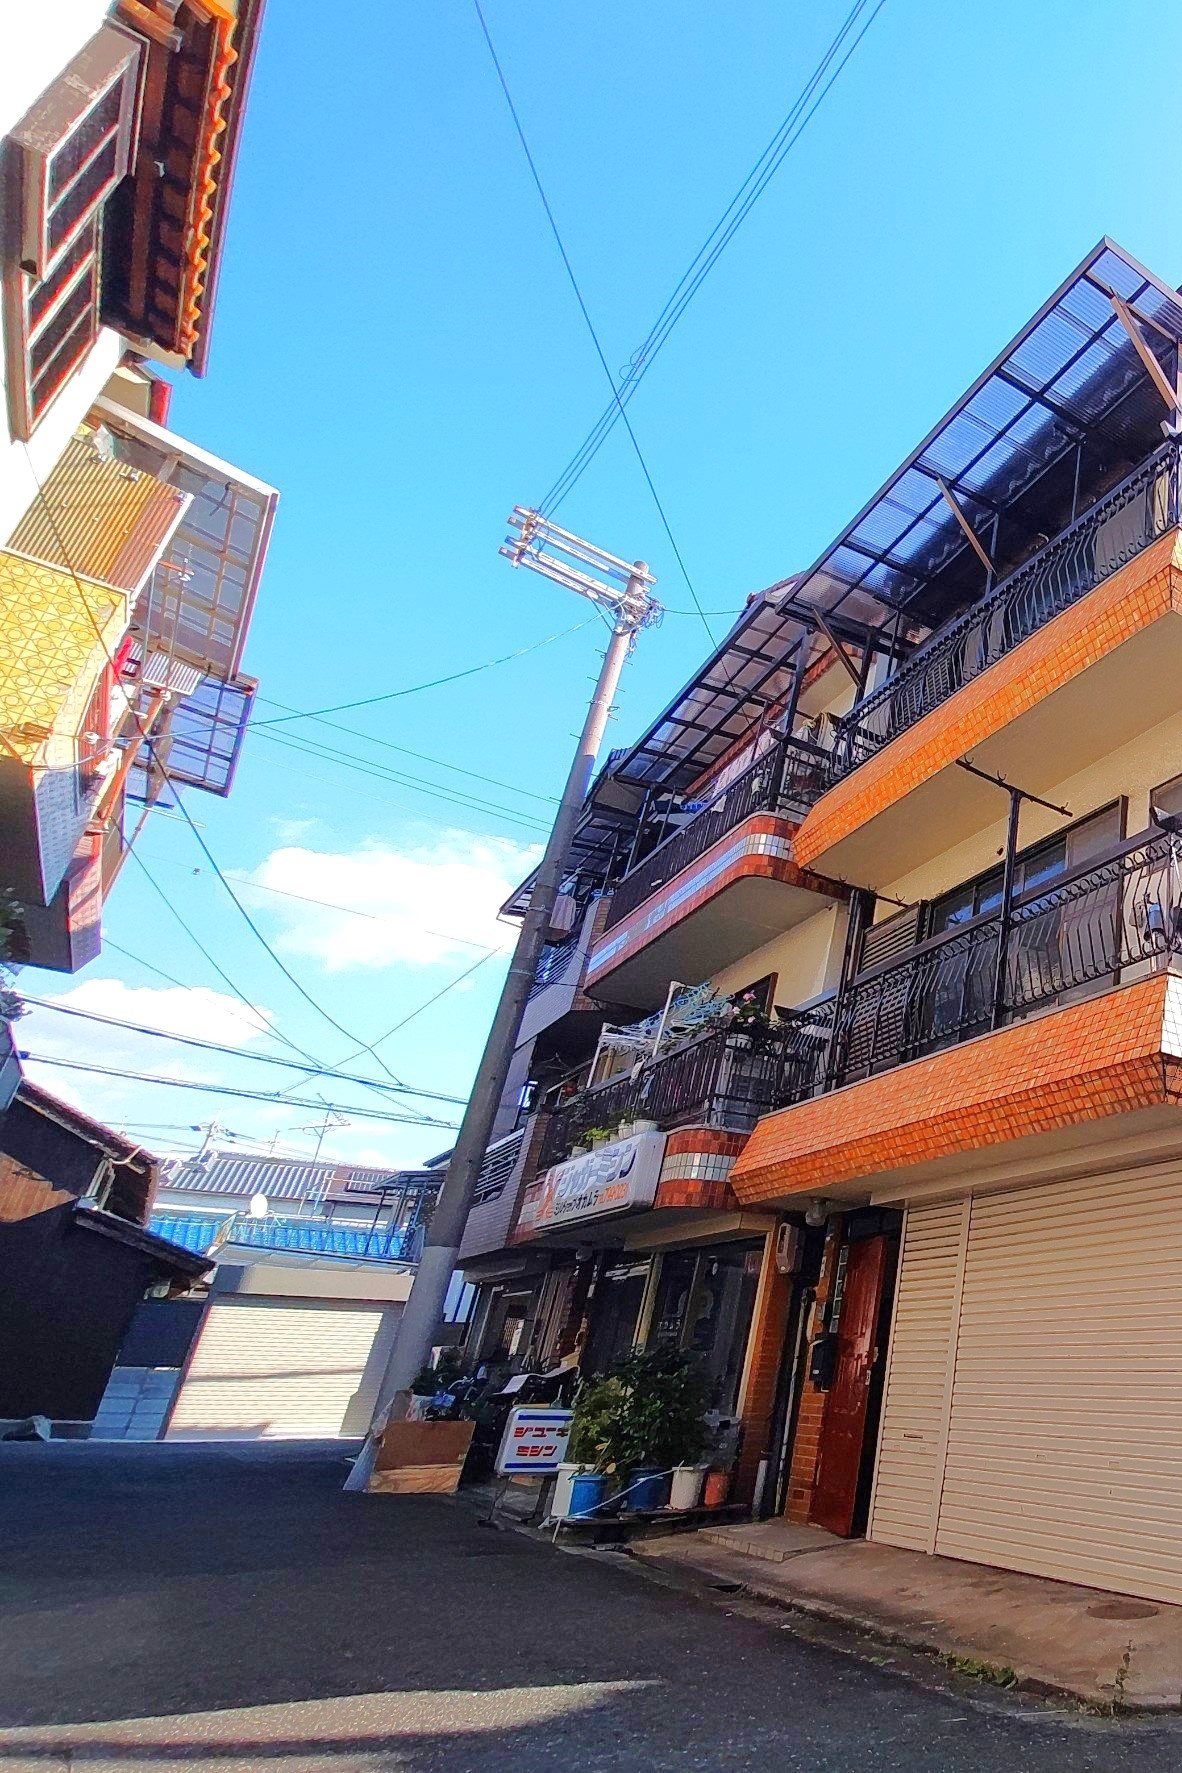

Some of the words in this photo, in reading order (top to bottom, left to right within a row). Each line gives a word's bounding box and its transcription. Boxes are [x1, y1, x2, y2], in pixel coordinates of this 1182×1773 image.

[514, 1427, 570, 1437] ジューキ
[516, 1445, 558, 1456] ミシン
